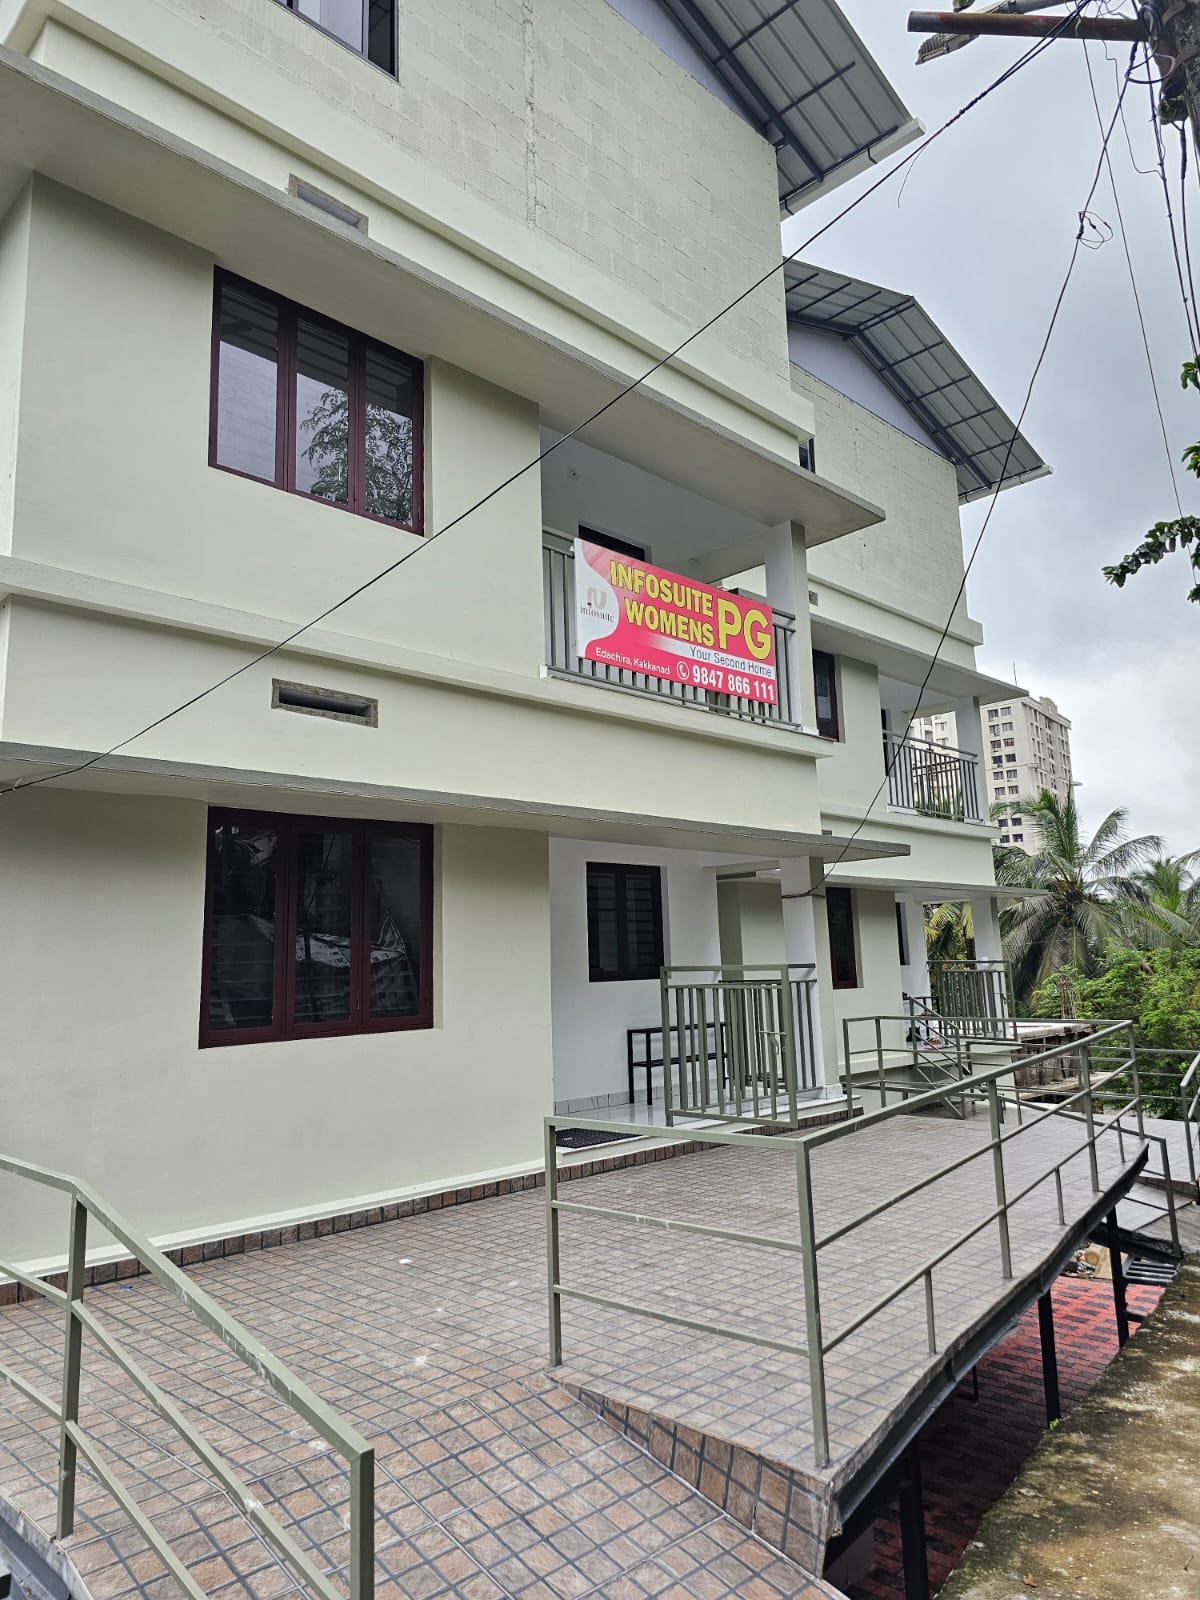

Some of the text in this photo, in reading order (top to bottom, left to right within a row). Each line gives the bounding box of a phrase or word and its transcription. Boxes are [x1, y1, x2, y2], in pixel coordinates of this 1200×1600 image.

[609, 560, 714, 618] INFOSUITE
[624, 597, 715, 647] WOMENS
[717, 598, 771, 660] PG
[595, 647, 670, 675] Edachira, Kakkanad
[689, 646, 773, 678] Your Second Home
[692, 665, 774, 700] 9847 866 111
